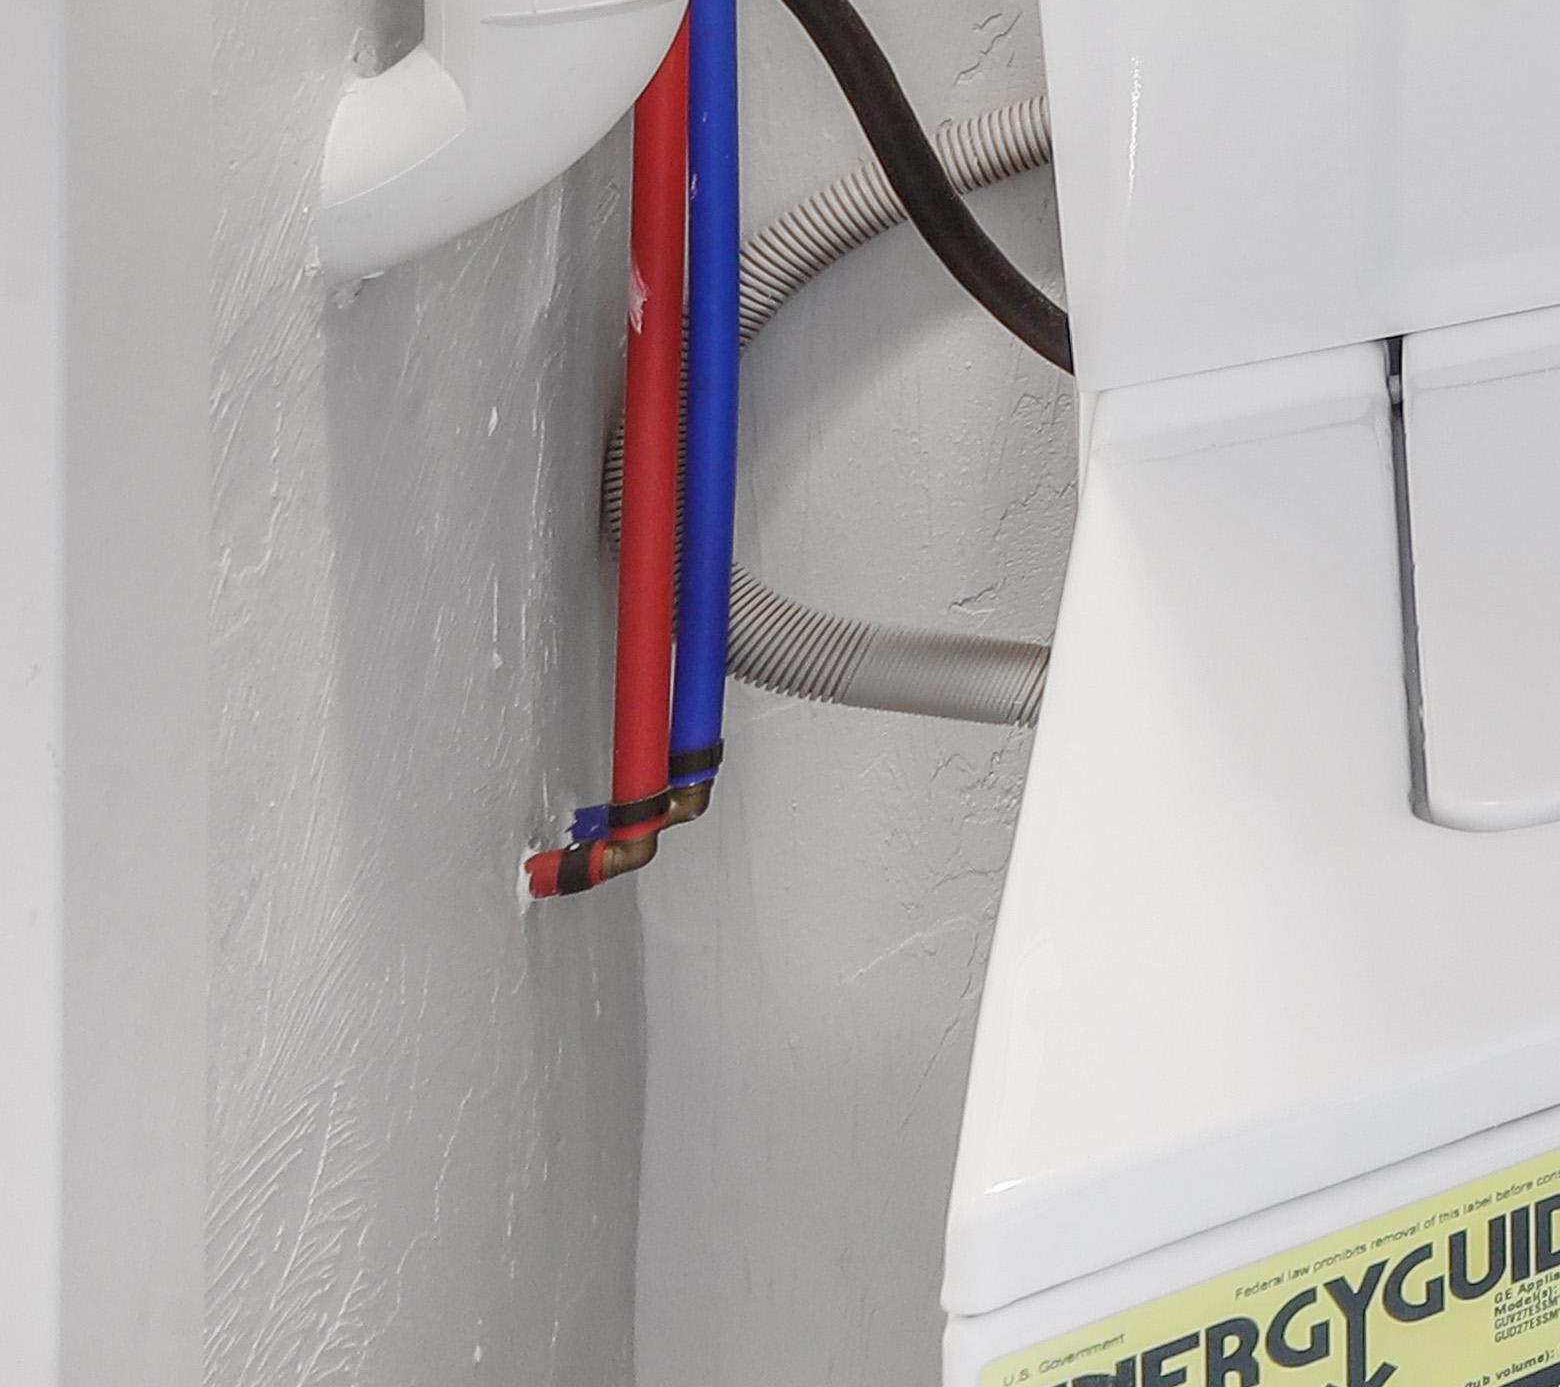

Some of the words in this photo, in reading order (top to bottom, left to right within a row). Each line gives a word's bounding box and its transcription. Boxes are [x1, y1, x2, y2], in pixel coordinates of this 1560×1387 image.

[1235, 1274, 1284, 1300] Federal
[1287, 1266, 1310, 1280] law
[1313, 1244, 1367, 1273] prohibits
[1370, 1223, 1422, 1250] removal
[1424, 1215, 1436, 1229] of
[1439, 1208, 1460, 1224] this
[1496, 1181, 1534, 1202] before
[1039, 1334, 1125, 1375] Government
